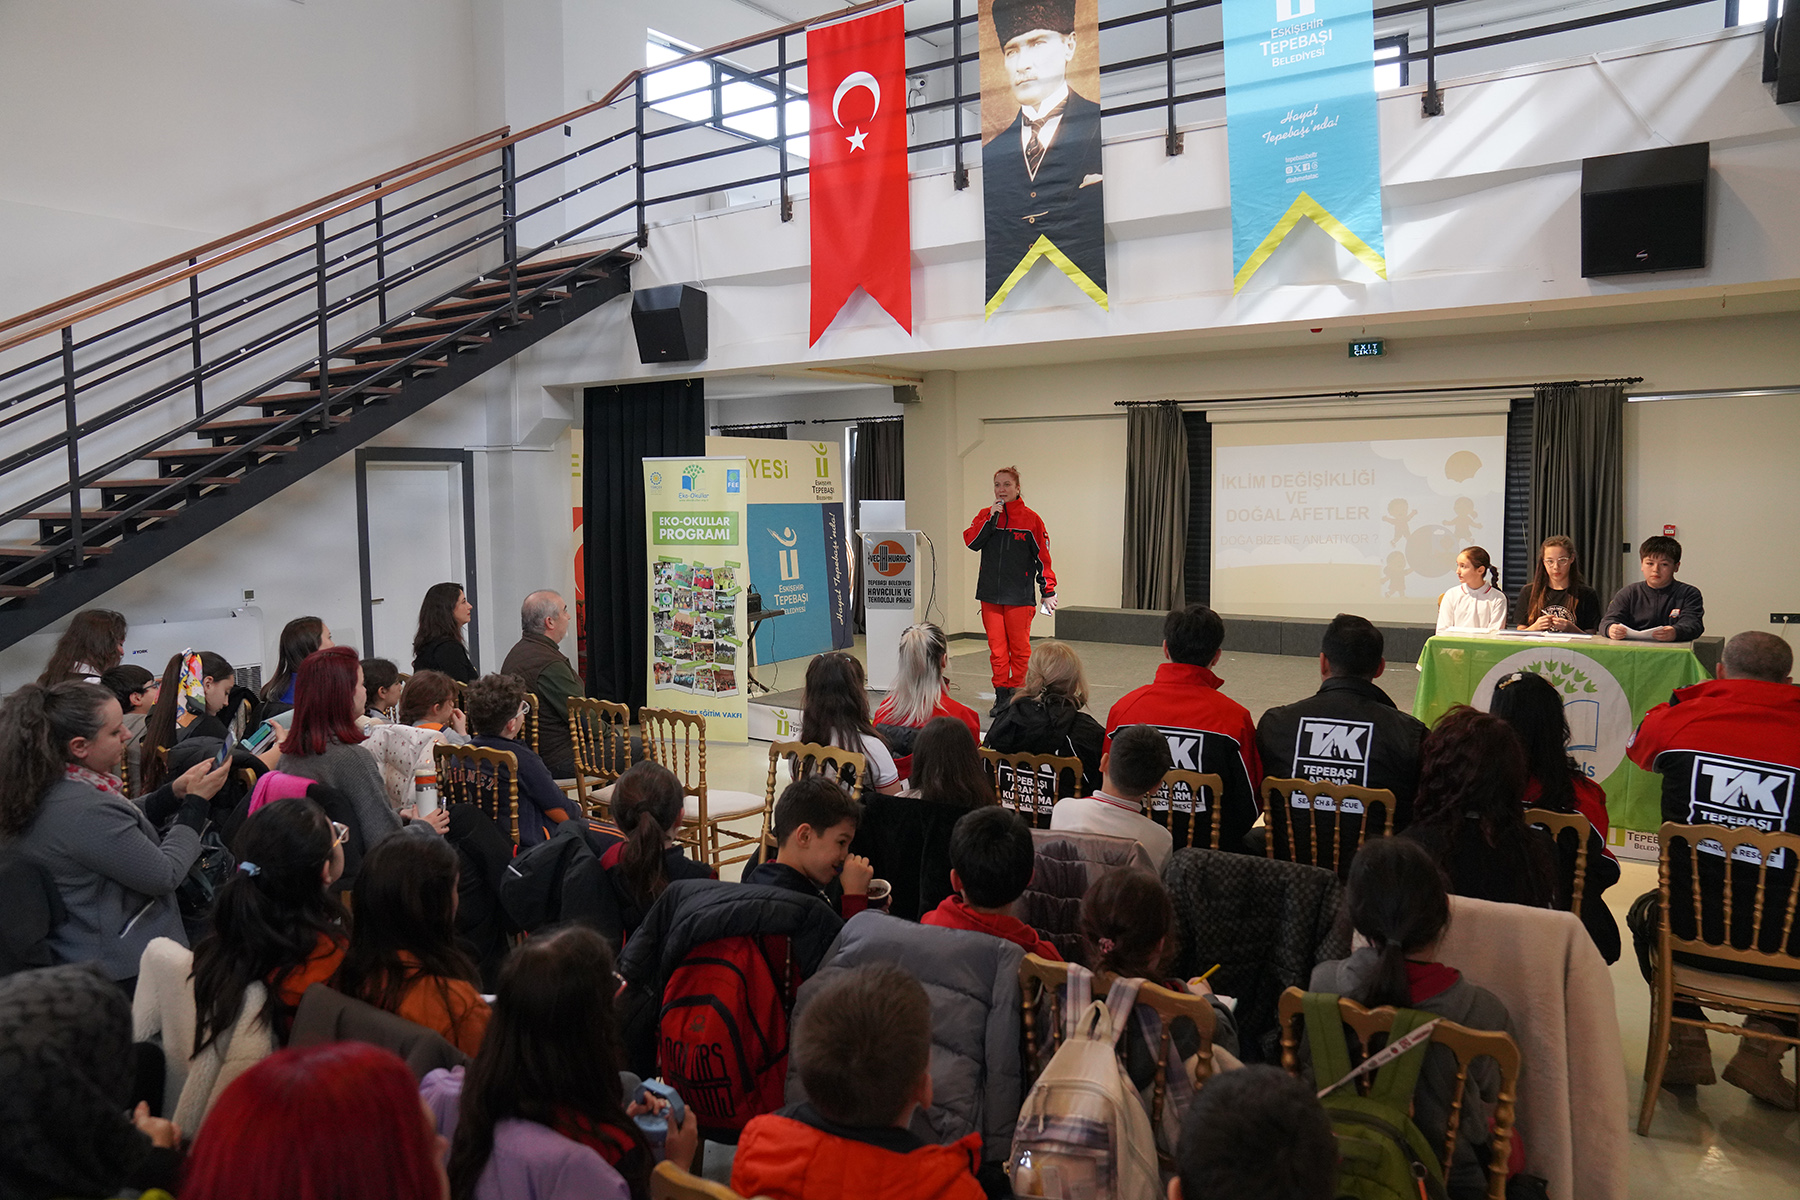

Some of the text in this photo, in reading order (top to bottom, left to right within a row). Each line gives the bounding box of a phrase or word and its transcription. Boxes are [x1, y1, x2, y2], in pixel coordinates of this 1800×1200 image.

[1259, 29, 1333, 57] TEPEBAŞI
[1272, 46, 1325, 68] BELEDİYESİ
[1280, 104, 1319, 125] Hayat
[1262, 115, 1340, 146] Tepebaşı'nda!
[1354, 343, 1378, 351] EXIT
[1221, 469, 1376, 491] İKLİM DEĞİŞİKLİĞİ
[1285, 491, 1308, 505] VE
[659, 516, 730, 526] EKO-OKULLAR
[1226, 506, 1370, 522] DOĞAL AFETLER
[659, 528, 730, 540] PROGRAMI
[1220, 533, 1254, 546] DOĞA
[1255, 533, 1281, 545] BİZE
[1283, 535, 1300, 545] NE
[1303, 533, 1369, 545] ANLATIYOR
[774, 593, 809, 606] TEPEBAŞI
[903, 588, 911, 596] VE
[1304, 723, 1368, 760] TAK
[1303, 765, 1357, 779] TEPEBAŞI
[1701, 764, 1786, 813] TAK
[1701, 811, 1772, 831] TEPEBAŞI
[1699, 840, 1723, 851] SEARC
